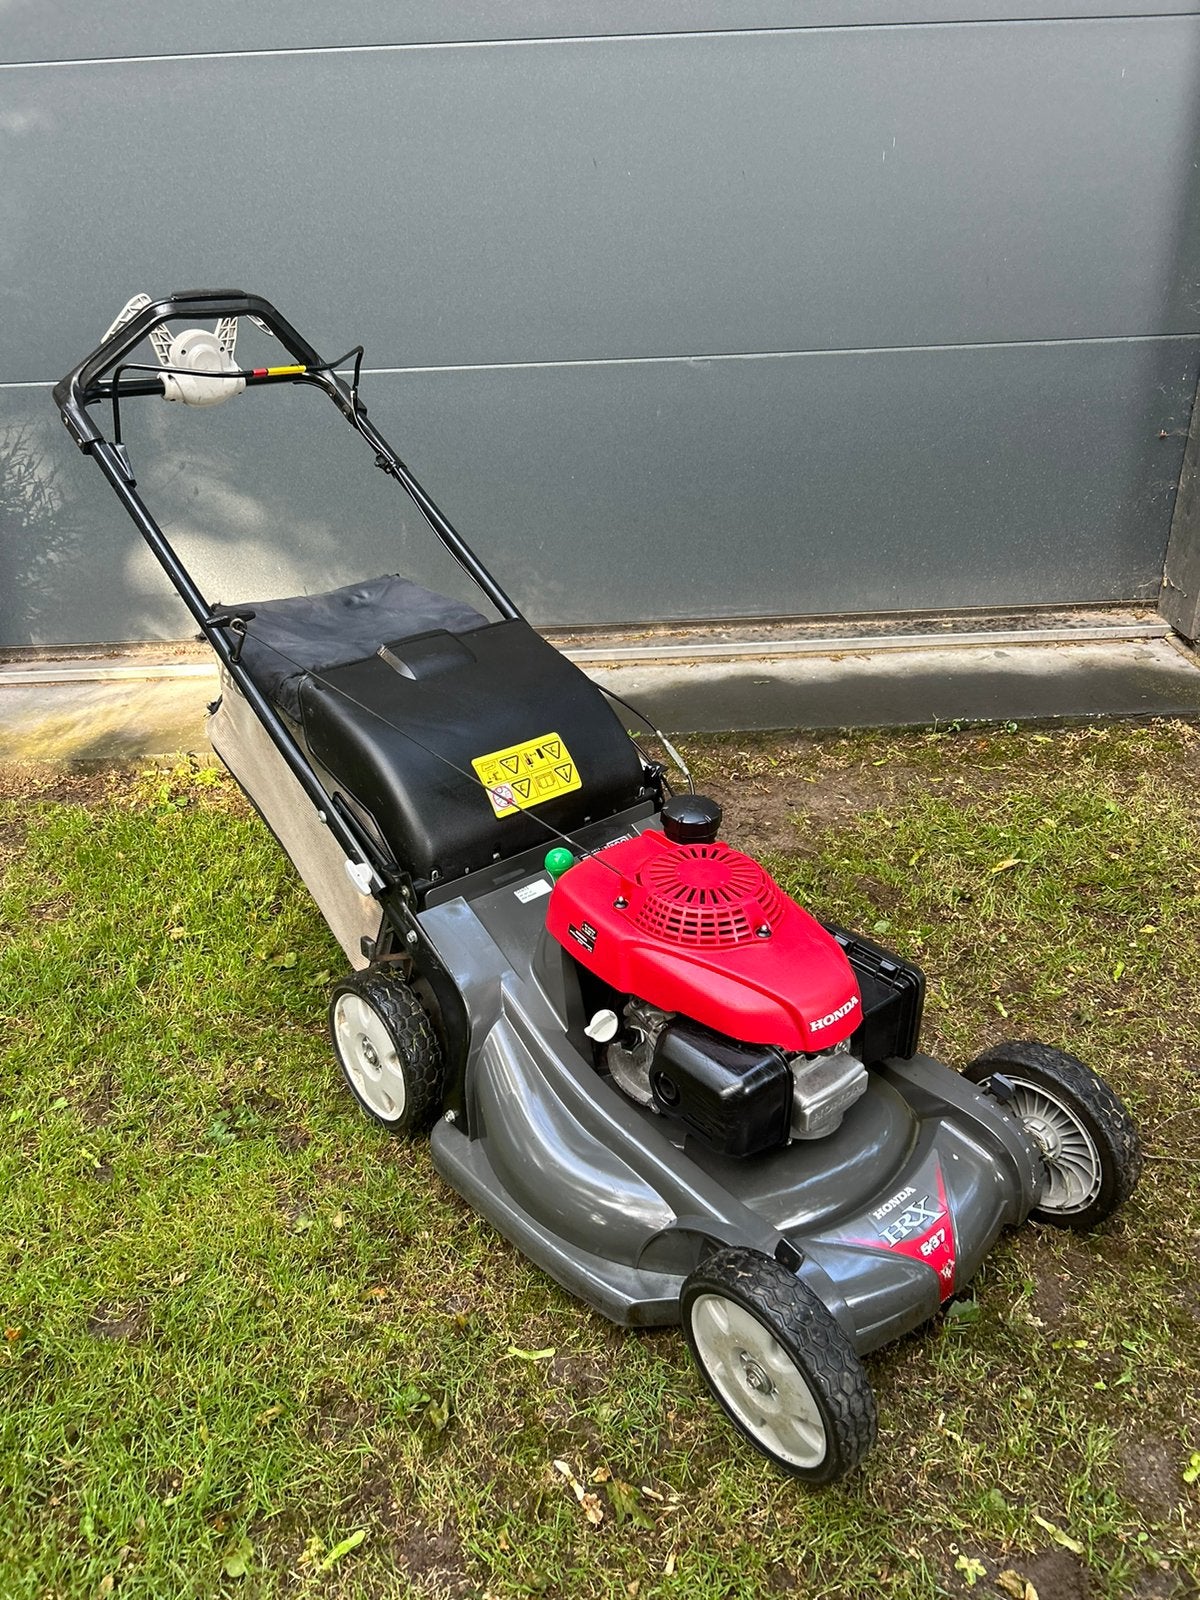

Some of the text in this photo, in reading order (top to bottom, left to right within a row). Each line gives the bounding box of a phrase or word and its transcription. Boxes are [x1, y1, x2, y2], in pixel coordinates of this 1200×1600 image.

[809, 995, 859, 1032] HONDA
[872, 1186, 917, 1220] HONDA
[879, 1195, 947, 1248] HRX
